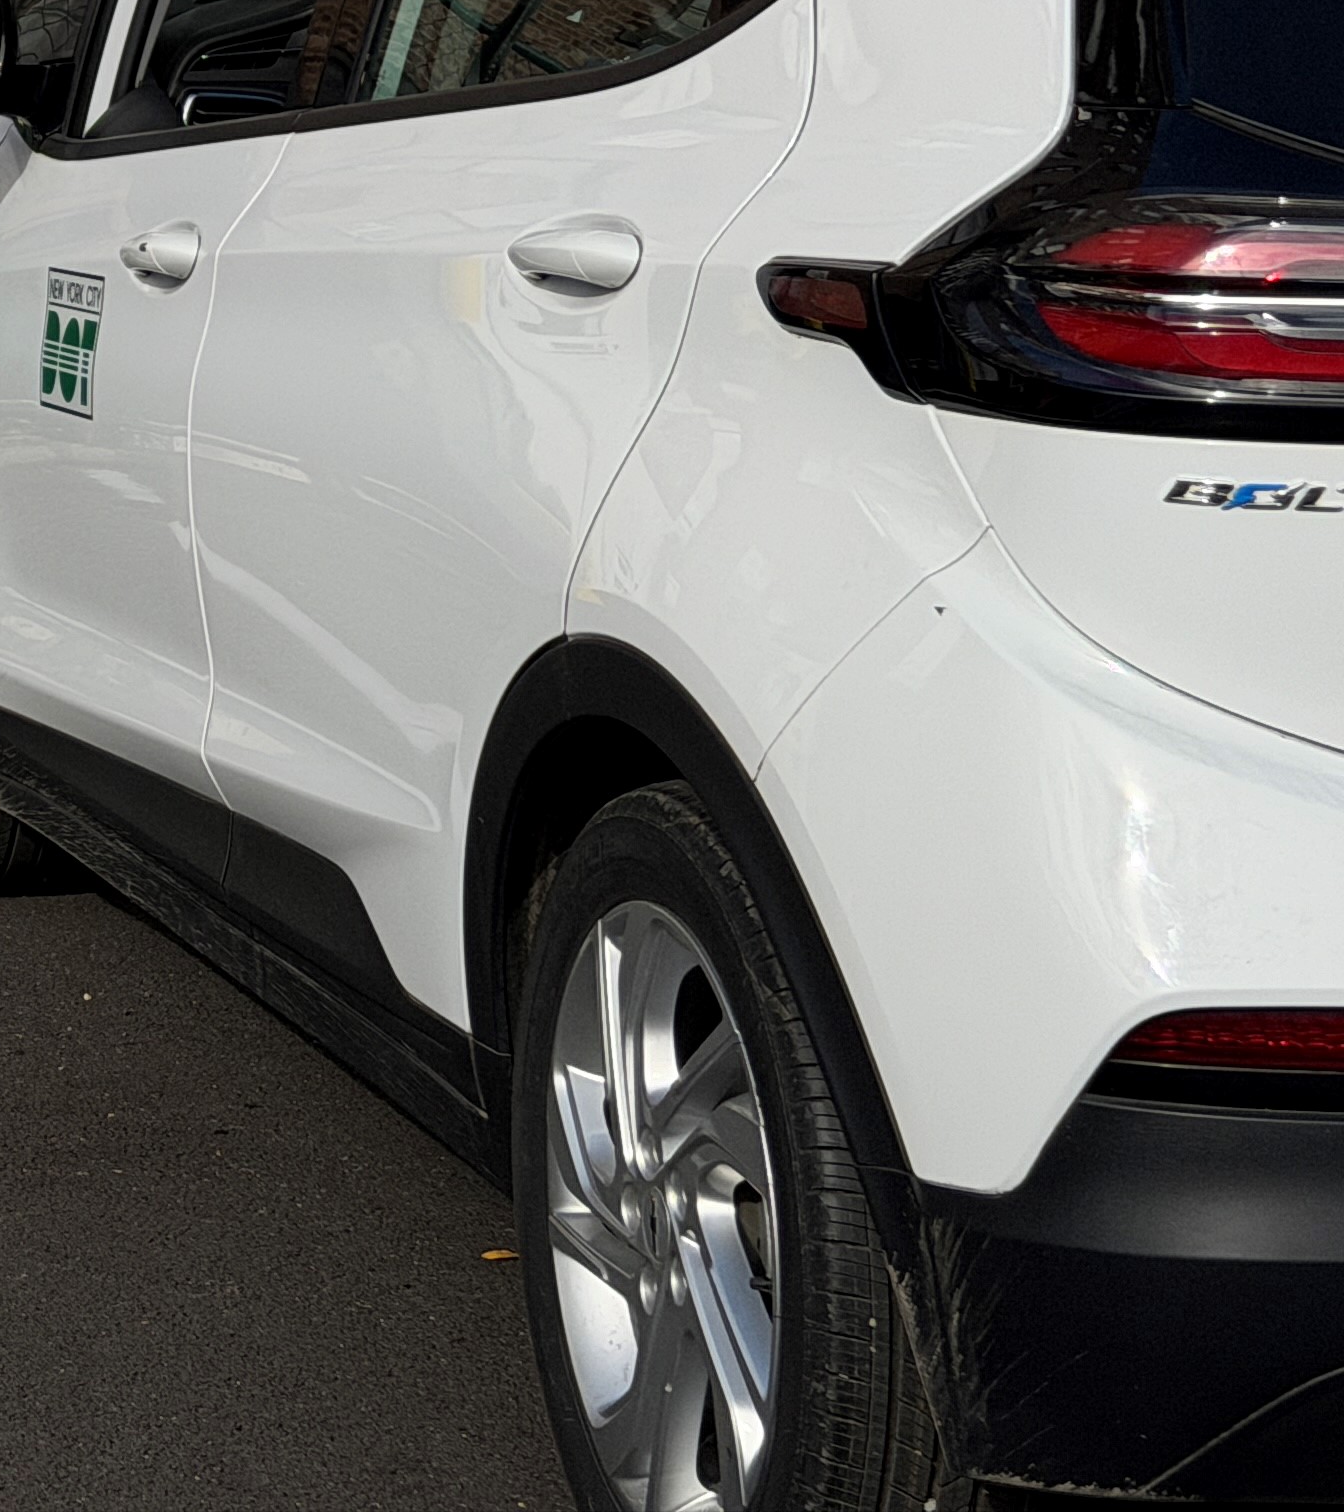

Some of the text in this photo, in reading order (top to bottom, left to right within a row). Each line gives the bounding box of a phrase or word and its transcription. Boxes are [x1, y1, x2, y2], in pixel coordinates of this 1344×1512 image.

[49, 278, 102, 308] NEW YORK CITY
[1162, 477, 1344, 513] BOL
